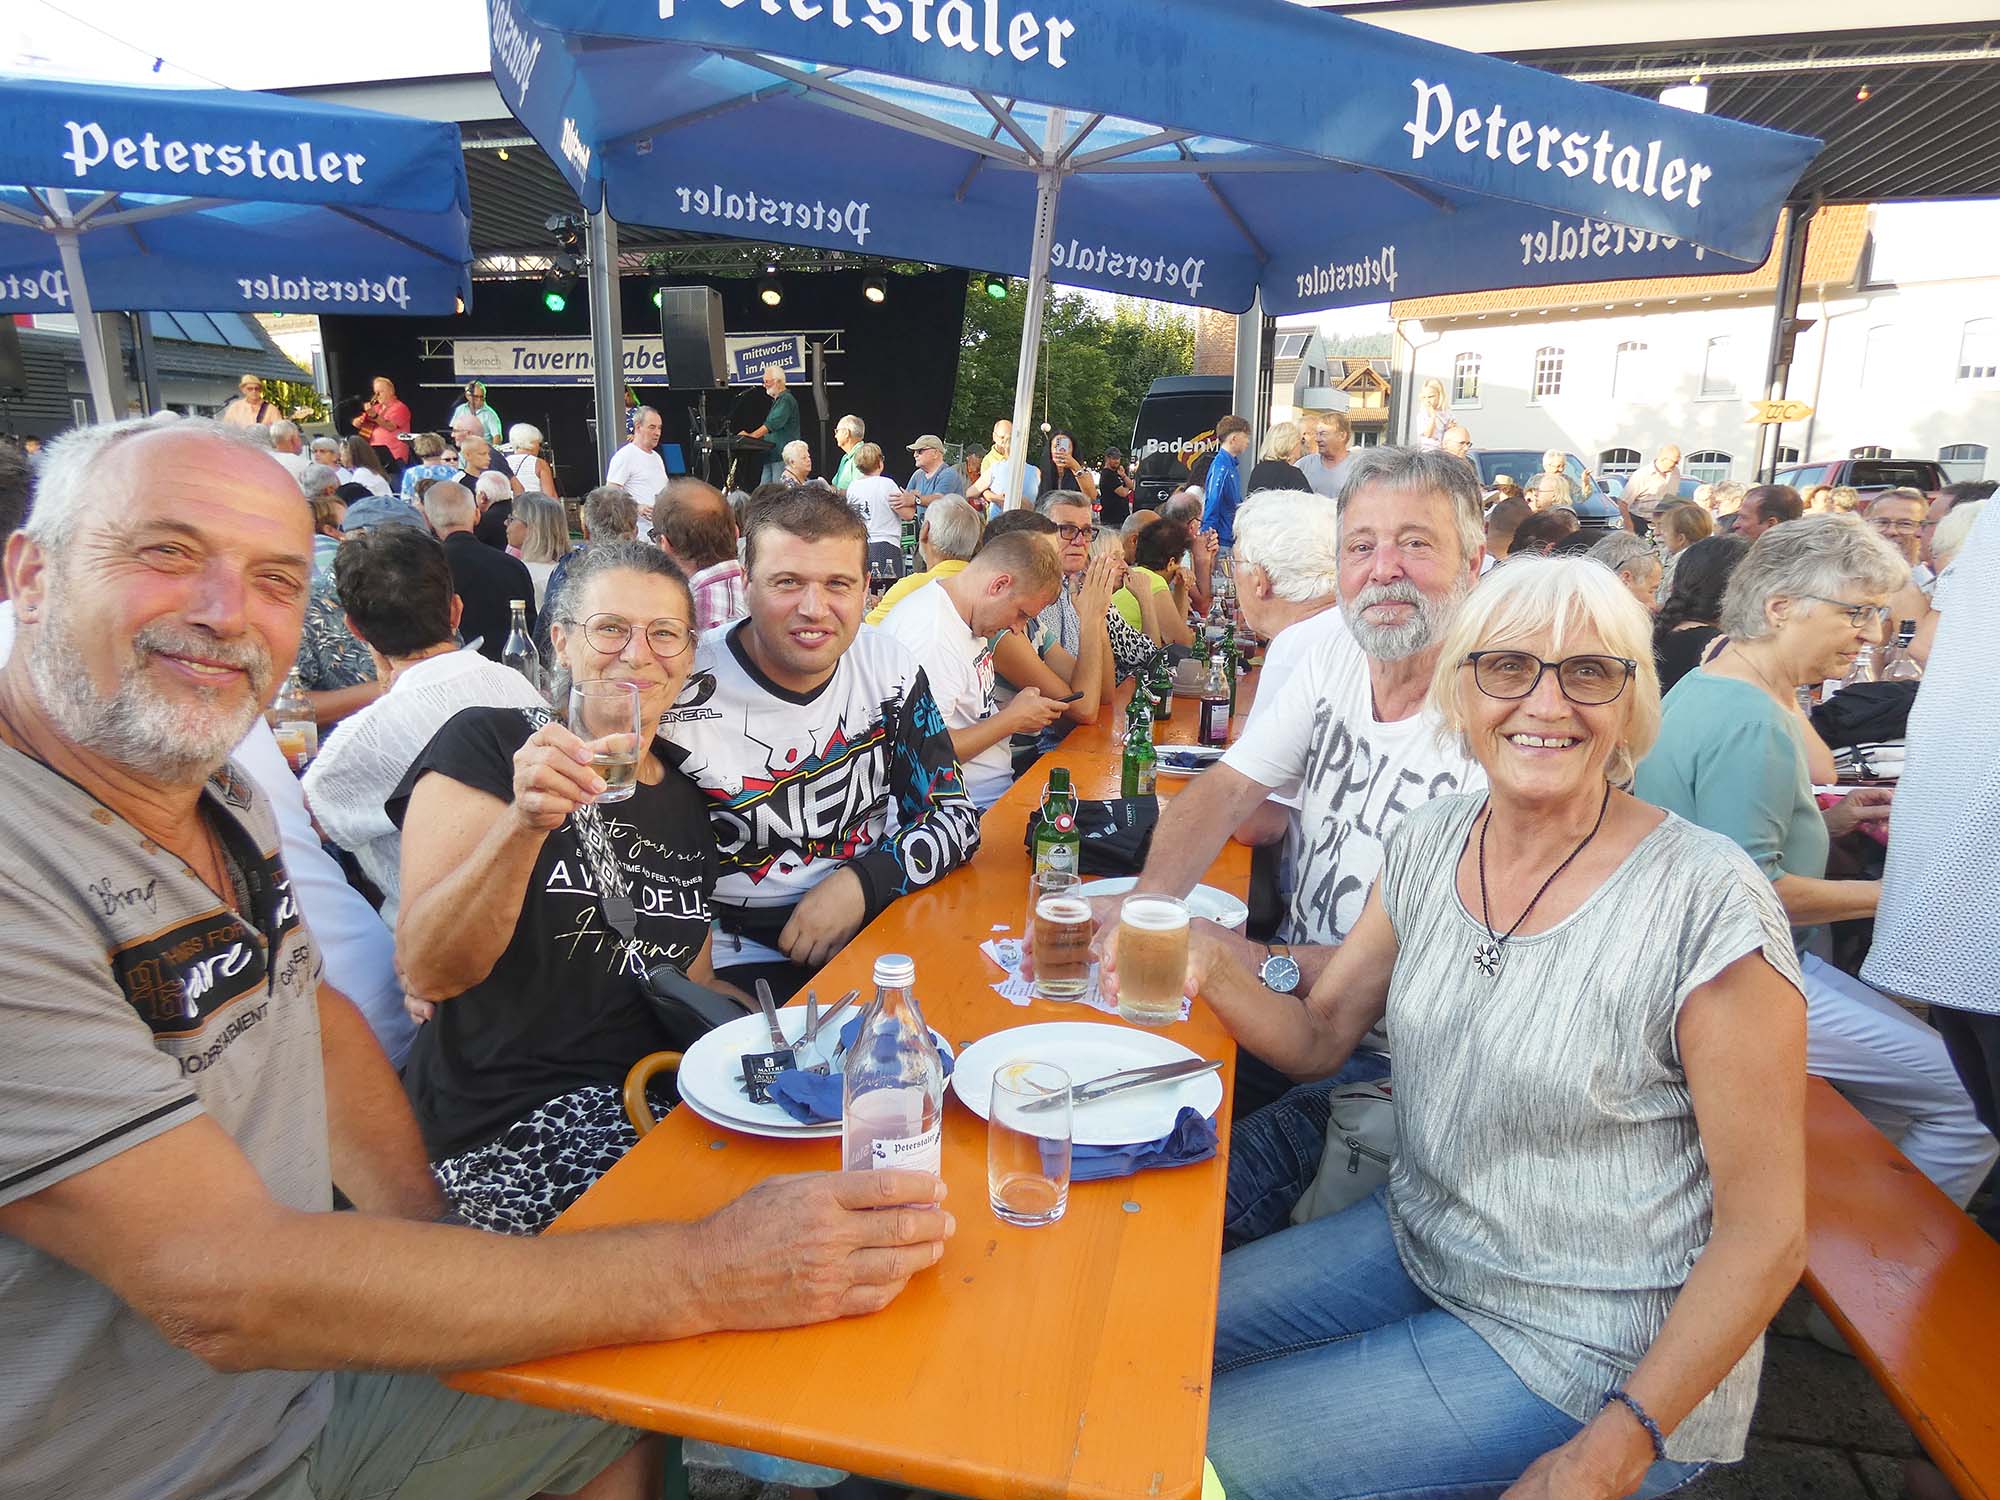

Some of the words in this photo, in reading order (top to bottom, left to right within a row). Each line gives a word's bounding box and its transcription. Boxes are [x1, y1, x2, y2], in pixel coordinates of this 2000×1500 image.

[656, 0, 1076, 69] rstaler
[62, 121, 367, 186] Peterstaler
[1403, 78, 1713, 208] Peterstaler
[742, 342, 793, 360] mittwochs
[745, 364, 758, 375] im
[651, 872, 669, 883] FEEL
[642, 885, 673, 911] OF
